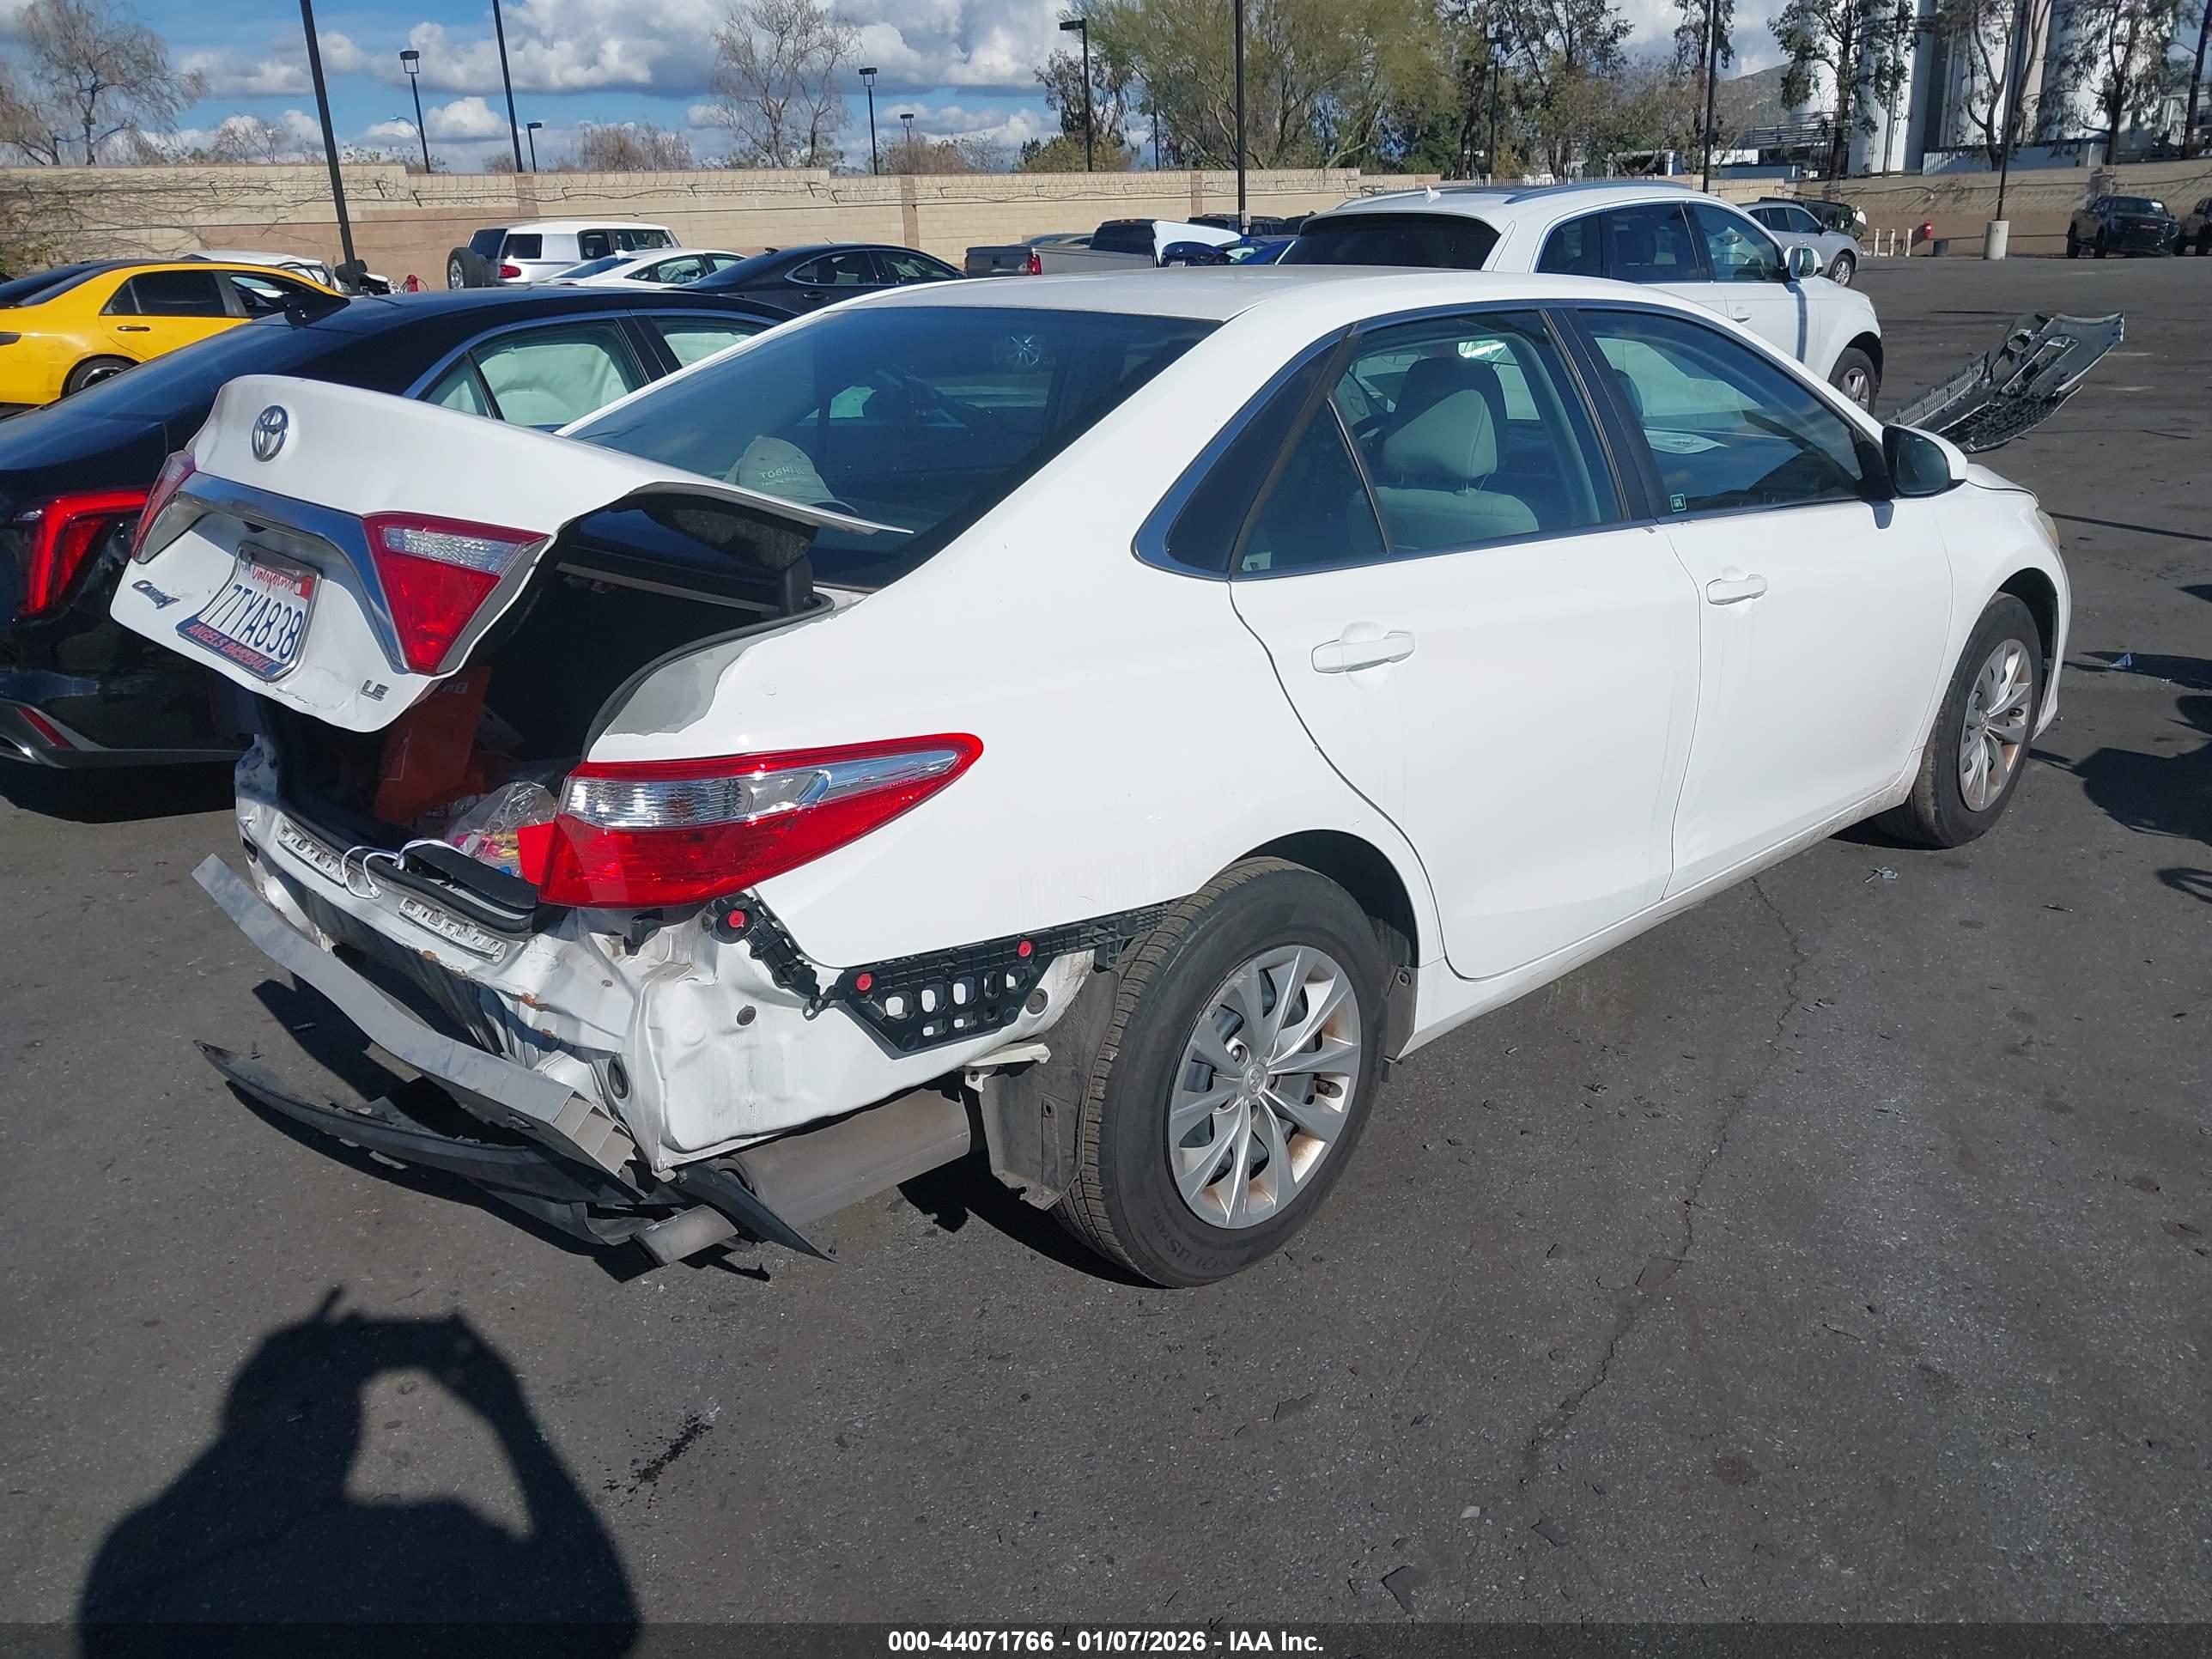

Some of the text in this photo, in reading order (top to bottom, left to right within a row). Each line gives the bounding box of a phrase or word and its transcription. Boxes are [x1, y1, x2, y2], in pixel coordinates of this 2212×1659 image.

[206, 584, 303, 659] 7TYA838
[185, 624, 274, 672] ANGELS BASEBALL
[361, 680, 389, 702] LE
